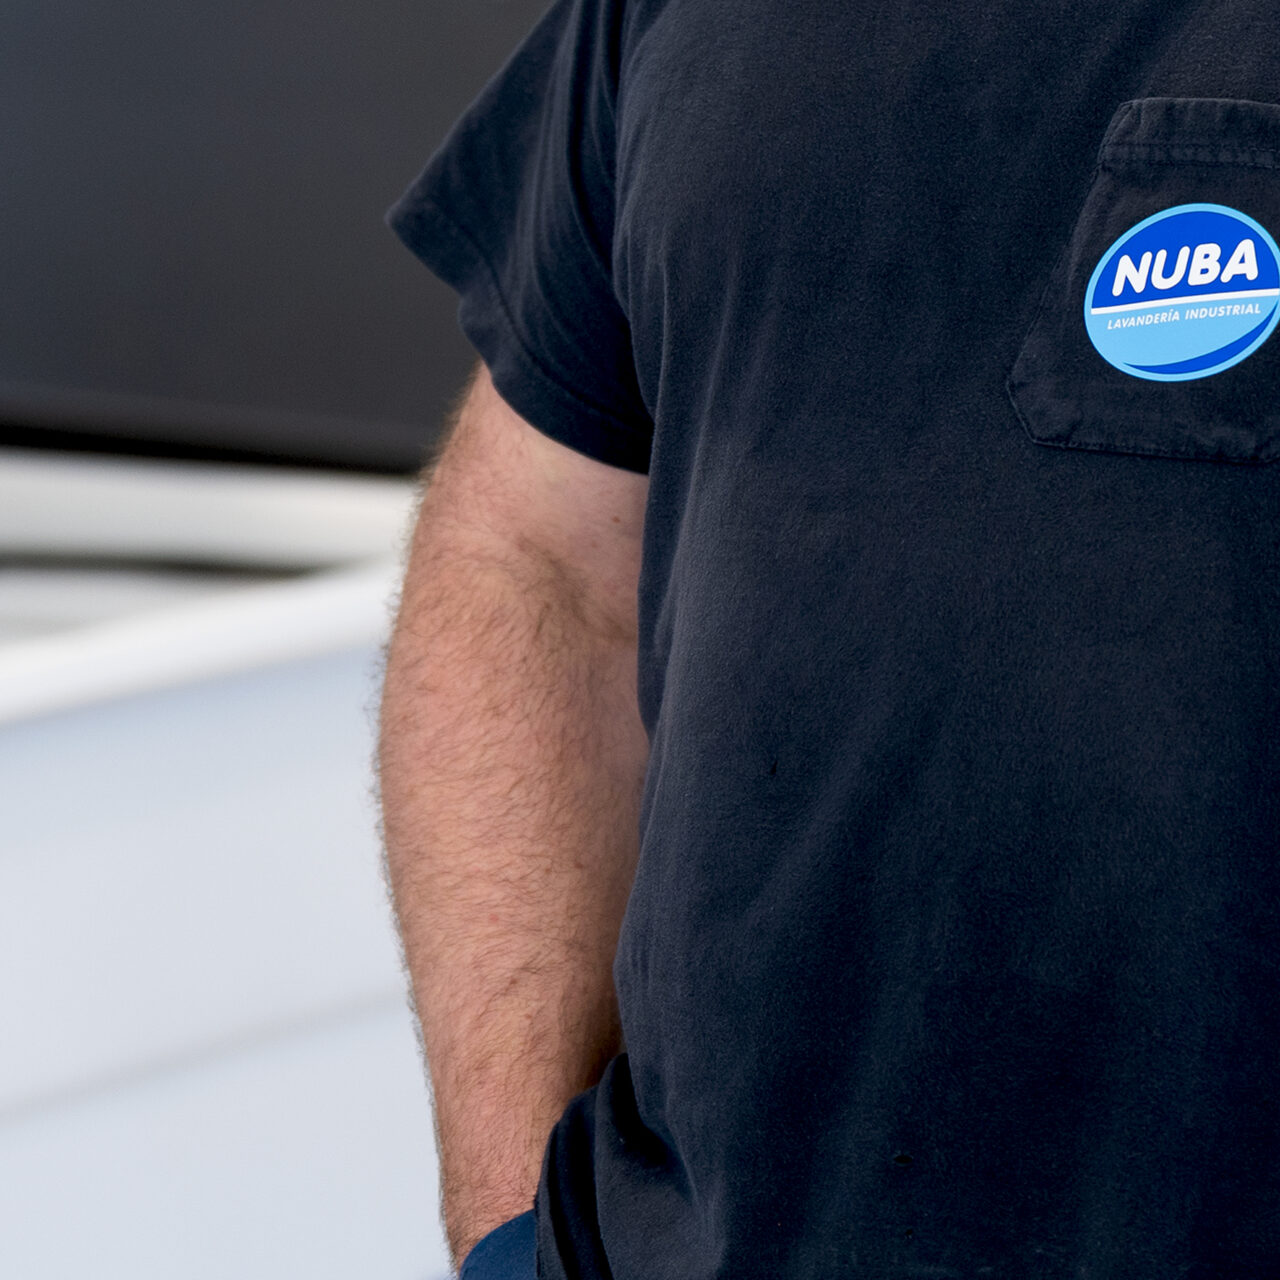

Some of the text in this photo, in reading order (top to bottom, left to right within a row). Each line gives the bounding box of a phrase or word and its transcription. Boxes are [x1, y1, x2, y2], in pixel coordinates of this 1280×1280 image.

[1112, 238, 1259, 297] NUBA
[1107, 303, 1261, 331] LAVANDERÍA INDUSTRIAL
